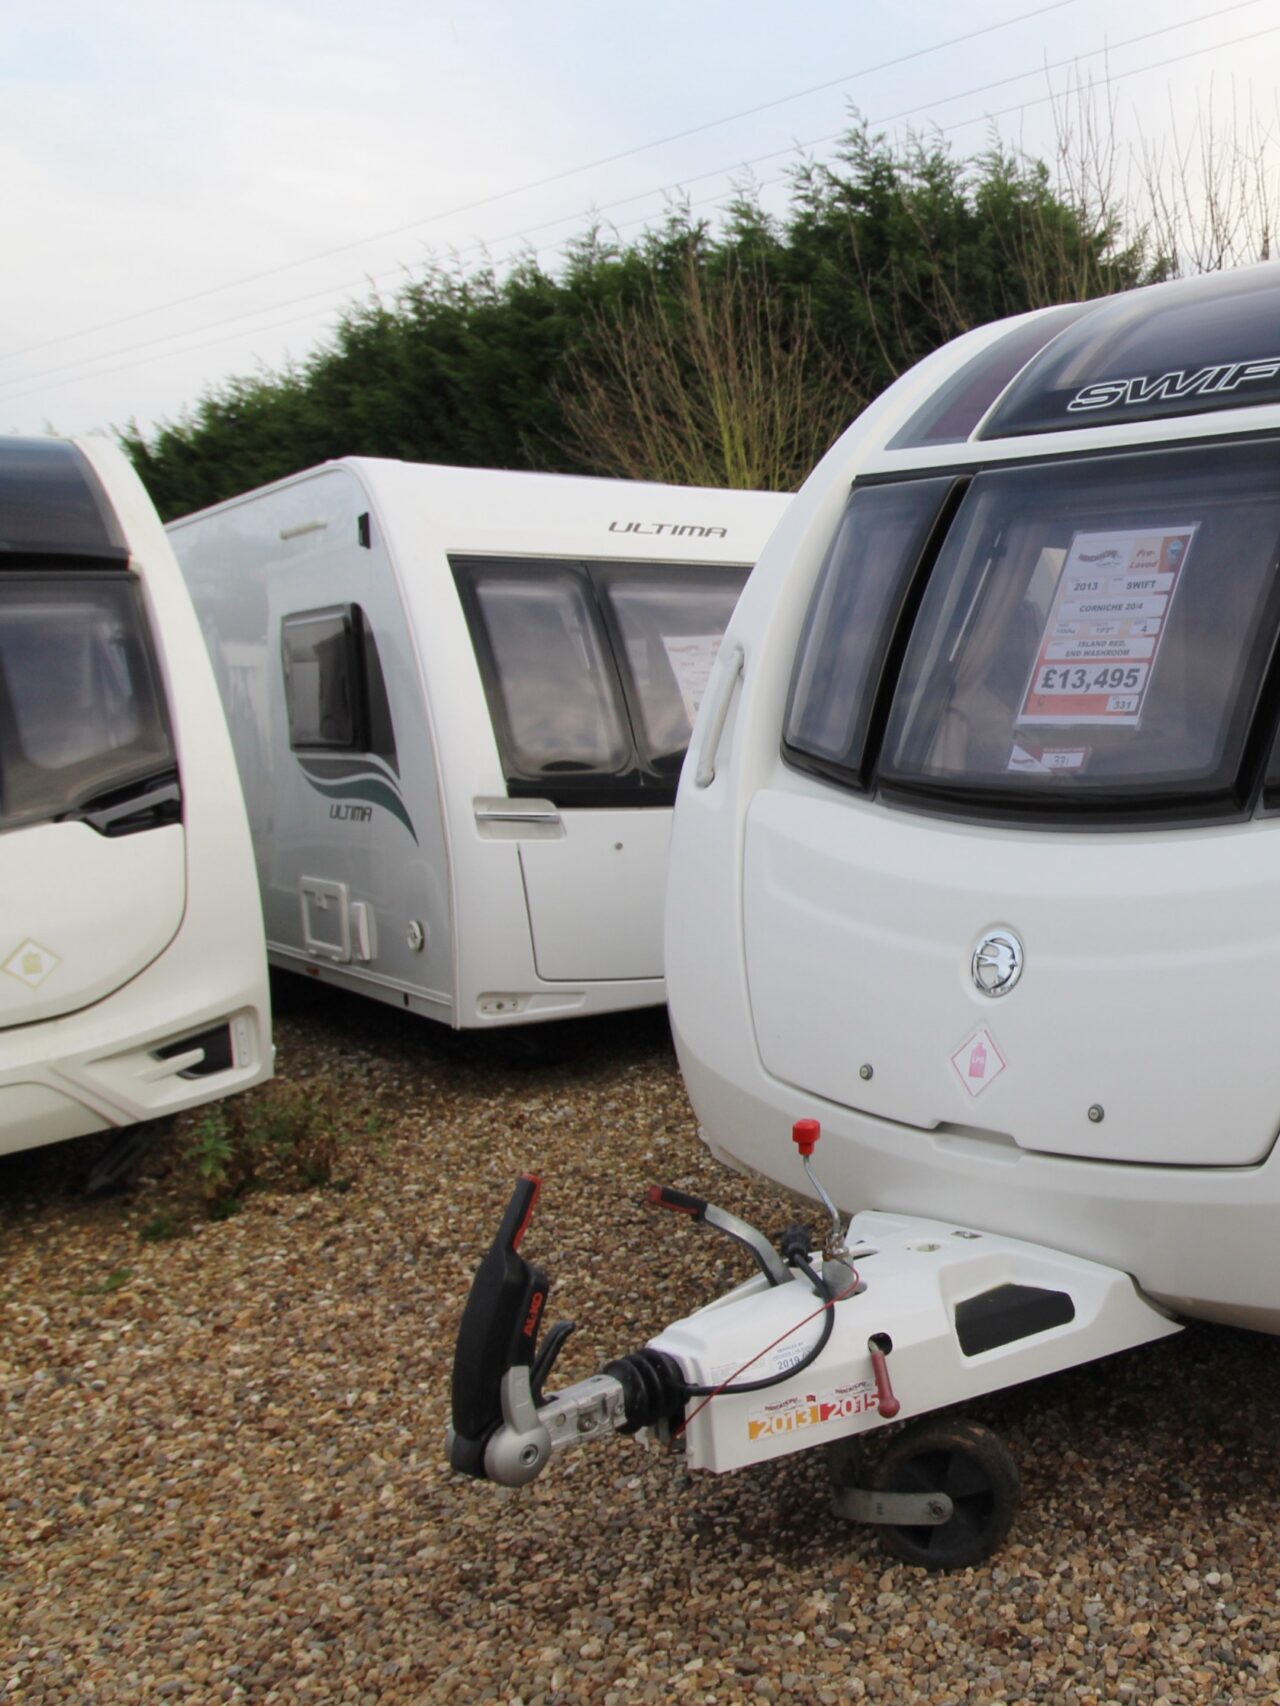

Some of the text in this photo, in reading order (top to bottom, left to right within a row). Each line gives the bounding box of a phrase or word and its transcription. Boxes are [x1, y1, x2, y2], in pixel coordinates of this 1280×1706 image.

[608, 521, 728, 538] ULTIMA
[1073, 582, 1098, 591] 2013
[1126, 580, 1156, 590] SWIFT
[1079, 604, 1123, 613] CORNICHE
[1078, 640, 1107, 648] ISLAND
[1083, 649, 1130, 657] WASHROOM
[1041, 668, 1140, 693] £13,495
[1113, 701, 1131, 709] 331
[329, 804, 373, 823] ULTIMA
